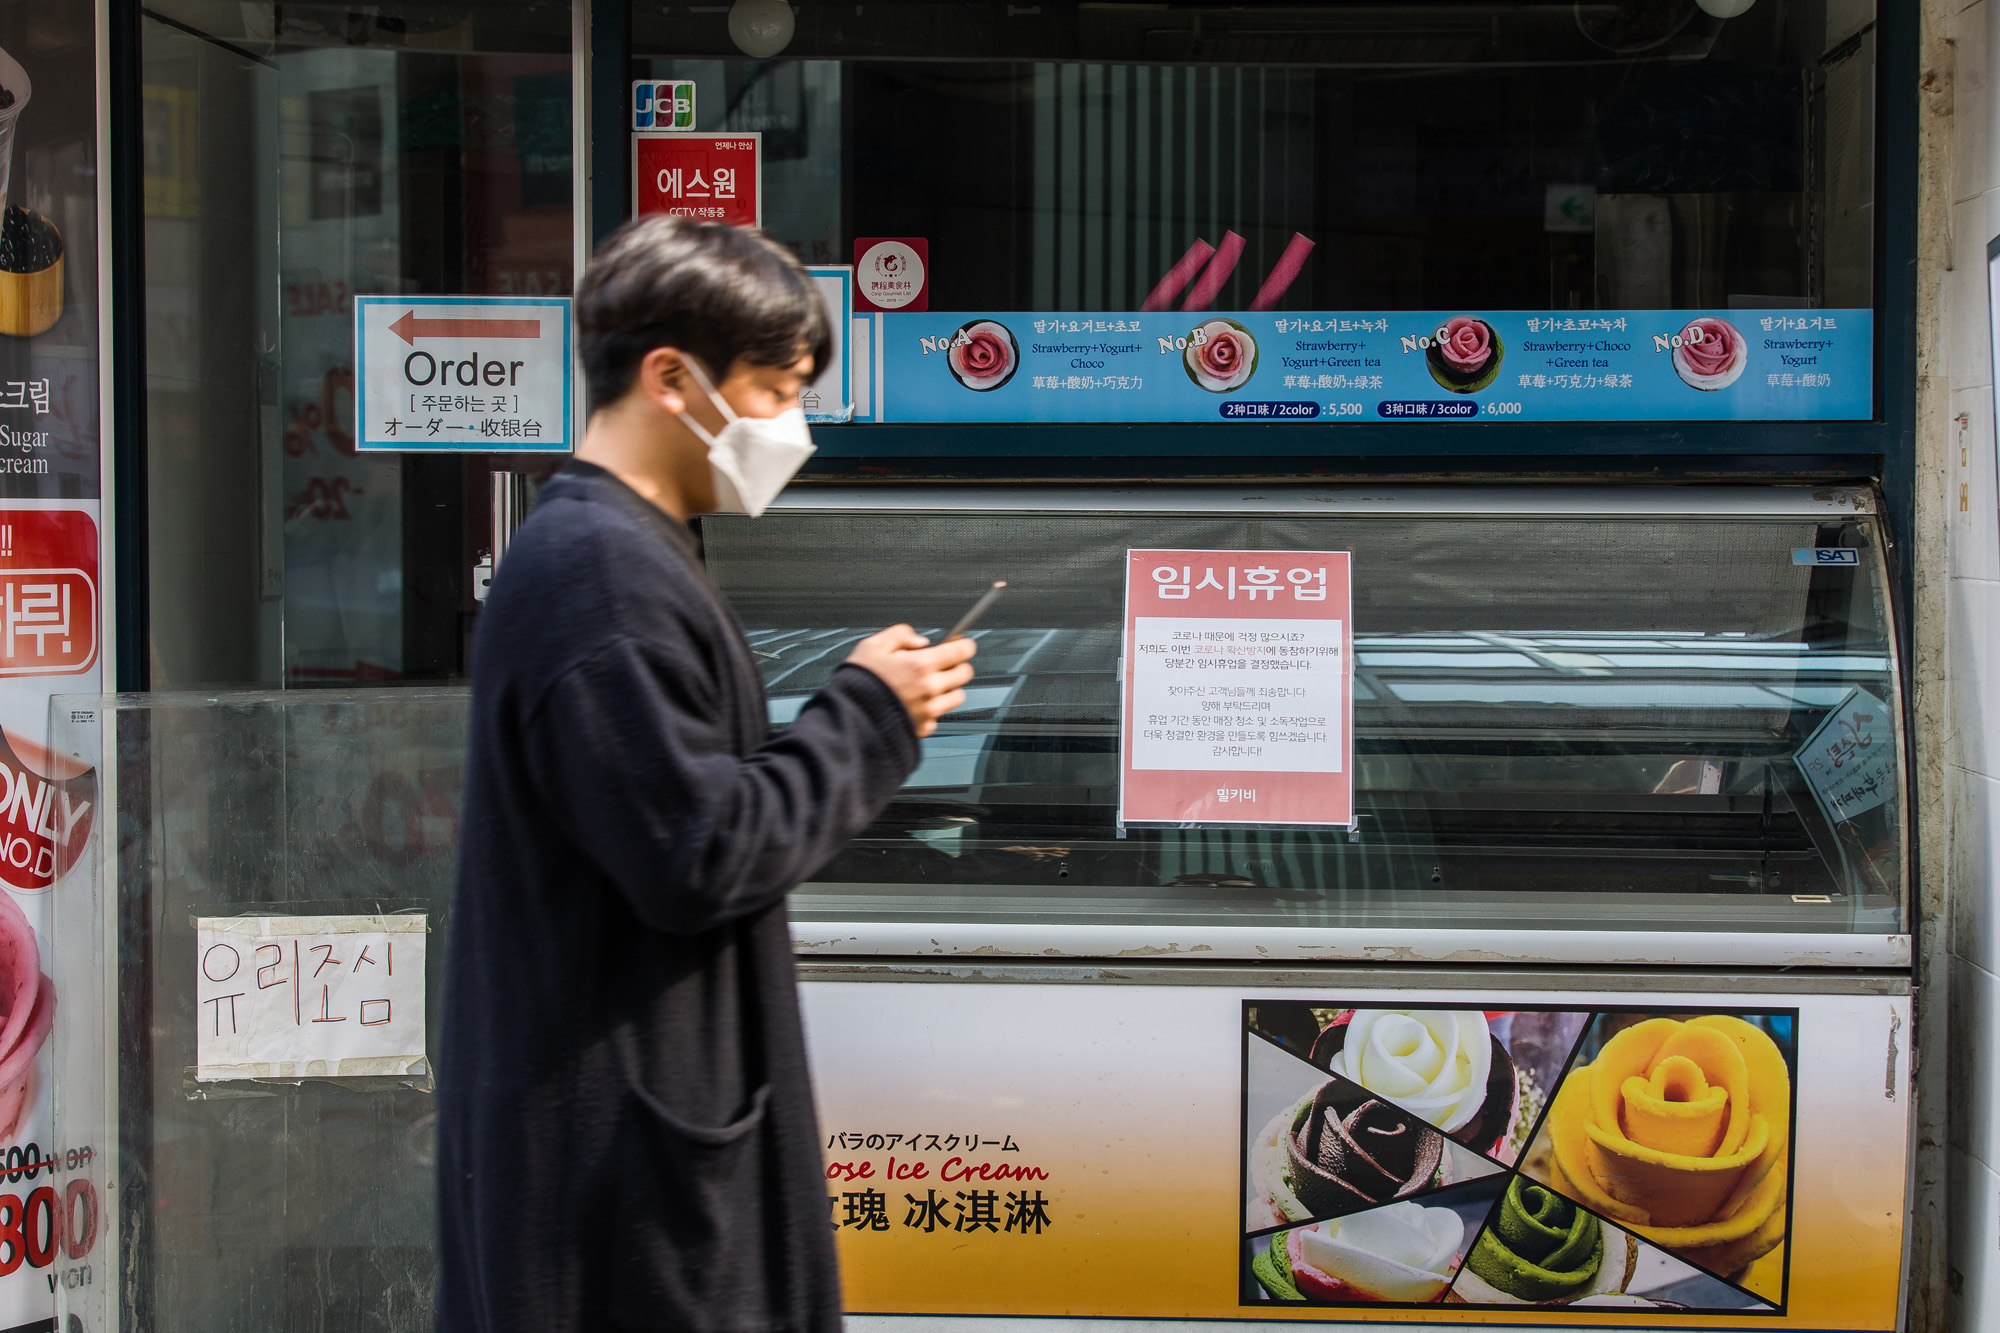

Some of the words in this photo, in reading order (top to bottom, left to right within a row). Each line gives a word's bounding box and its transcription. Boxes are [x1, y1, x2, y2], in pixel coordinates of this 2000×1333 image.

[635, 98, 690, 113] JCB
[715, 142, 737, 150] 언제나
[738, 142, 753, 150] 안심
[657, 168, 735, 199] 에스원
[669, 207, 696, 217] CCTV
[698, 207, 725, 218] 작동중
[1033, 319, 1142, 334] 딸기+요거트+초코
[1274, 318, 1389, 334] 딸기+요거트+녹차
[1526, 317, 1628, 333] 딸기+초코+녹차
[1760, 316, 1837, 331] 딸기+요거트
[919, 328, 973, 355] No.A
[1156, 327, 1208, 355] No.B
[1295, 340, 1366, 353] Strawberry+
[1400, 326, 1451, 355] No.C
[1652, 325, 1704, 353] No.D
[1764, 339, 1834, 352] Strawberry+
[1032, 343, 1143, 356] Strawberry+Yogurt+
[1523, 340, 1631, 354] Strawberry+Choco
[1070, 358, 1105, 369] Choco
[1281, 356, 1361, 369] Yogurt+Green
[1364, 357, 1381, 367] tea
[1546, 357, 1589, 368] +Green
[1592, 357, 1609, 368] tea
[1780, 354, 1817, 367] Yogurt
[404, 351, 524, 387] Order
[1032, 375, 1143, 390] 草莓+酸奶+巧克力
[1283, 374, 1383, 390] 草莓+酸奶+绿茶
[1518, 374, 1633, 389] 草莓+巧克力+绿茶
[1766, 373, 1831, 387] 草莓+酸奶
[0, 377, 50, 415] 크림
[797, 390, 821, 409] 台
[421, 395, 486, 412] 주문하는
[491, 395, 507, 413] 곳
[1227, 404, 1269, 416] 2种口味
[1279, 404, 1313, 416] 2color
[1385, 403, 1428, 415] 3种口味
[1437, 403, 1472, 415] 3color
[0, 424, 49, 448] Sugar
[0, 455, 49, 474] cream
[1815, 549, 1846, 561] ISA
[1151, 565, 1327, 601] 임시휴업
[1172, 632, 1203, 642] 코로나
[1205, 632, 1235, 642] 때문에
[1238, 632, 1257, 643] 걱정
[1260, 632, 1305, 643] 많으시죠?
[1139, 644, 1168, 655] 저희도
[1171, 644, 1191, 655] 이번
[1193, 645, 1223, 655] 코로나
[1226, 645, 1276, 656] 확산방지에
[1278, 645, 1339, 657] 동참하기위해
[1165, 658, 1195, 669] 당분간
[1197, 658, 1247, 670] 임시휴업을
[1250, 659, 1312, 670] 결정했습니다.
[1168, 686, 1206, 697] 찾아주신
[1208, 686, 1256, 697] 고객님들께
[1258, 686, 1307, 698] 죄송합니다.
[1201, 701, 1221, 711] 양해
[1223, 701, 1271, 712] 부탁드리며
[1148, 715, 1167, 726] 휴업
[1171, 715, 1189, 726] 기간
[1191, 715, 1211, 726] 동안
[1214, 716, 1233, 726] 매장
[1236, 716, 1255, 726] 청소
[1257, 716, 1267, 726] 및
[1269, 716, 1327, 727] 소독작업으로
[1143, 730, 1163, 741] 더욱
[1165, 730, 1194, 741] 청결한
[1197, 731, 1226, 742] 환경을
[1228, 731, 1266, 742] 만들도록
[1269, 731, 1328, 743] 힘쓰겠습니다.
[1212, 745, 1262, 757] 감사합니다!
[1217, 788, 1256, 803] 밀키비
[203, 940, 393, 1036] 유리조심
[827, 1131, 1020, 1152] バラのアイスクリーム
[824, 1160, 876, 1182] ose
[887, 1156, 929, 1180] Ice
[940, 1156, 1049, 1182] Cream
[903, 1188, 1052, 1235] 冰淇淋
